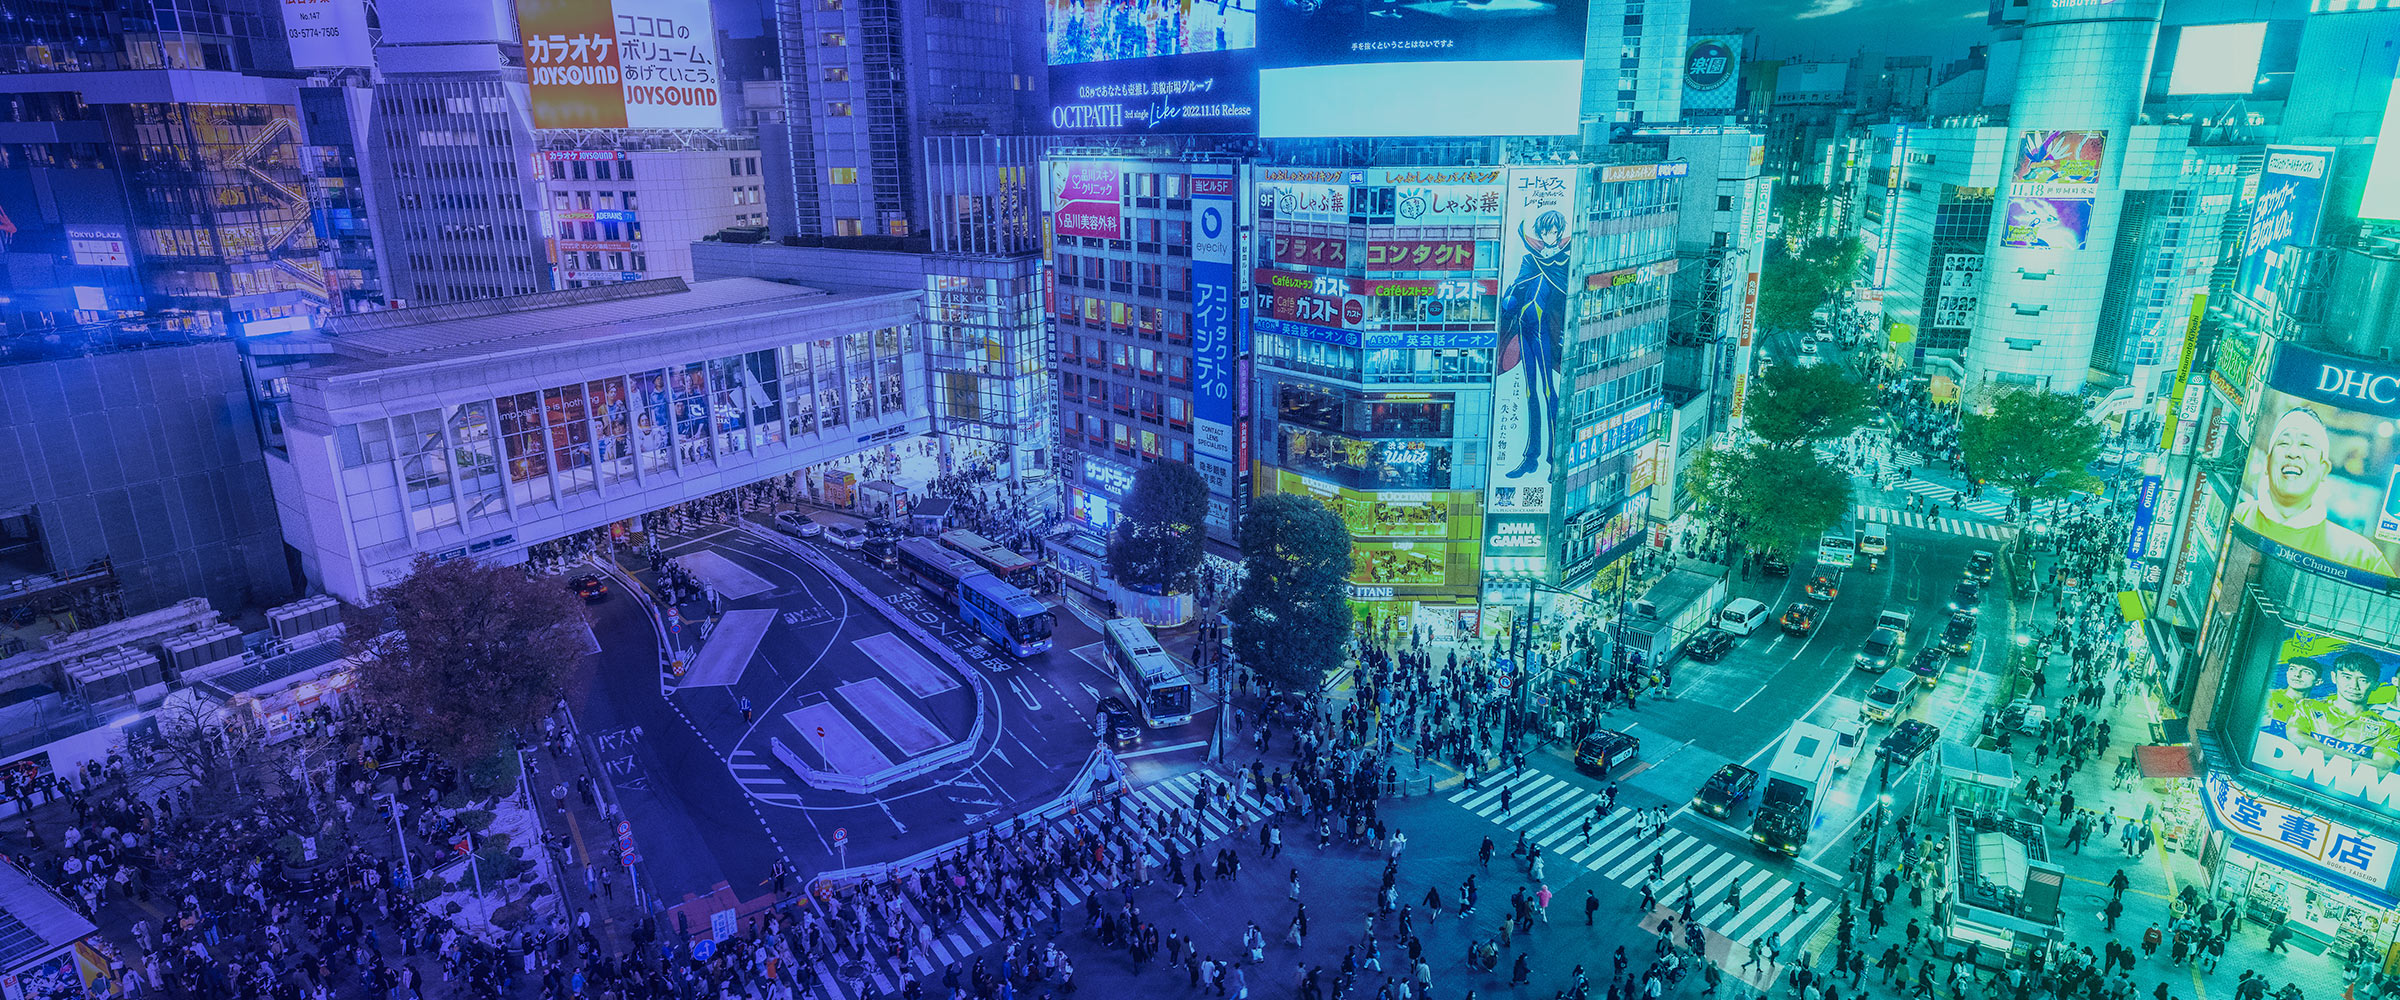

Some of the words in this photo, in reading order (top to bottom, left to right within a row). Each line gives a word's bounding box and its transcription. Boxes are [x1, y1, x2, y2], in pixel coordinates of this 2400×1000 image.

[300, 12, 320, 20] No.147
[618, 14, 690, 39] ココロの
[528, 33, 613, 64] カラオケ
[622, 39, 712, 65] ボリューム、
[1352, 40, 1454, 51] 手を抜くということはないですよ
[533, 65, 619, 85] JOYSOUND
[625, 64, 716, 84] あげていこう。
[1690, 57, 1727, 75] 楽園
[627, 85, 717, 106] JOYSOUND
[1053, 104, 1123, 128] OCTPATH
[1124, 110, 1134, 119] 3rd
[1148, 94, 1181, 129] Like
[1182, 105, 1220, 117] 2022.11.16
[1222, 104, 1251, 116] Release
[1081, 169, 1116, 182] 品川スキン
[1265, 169, 1342, 183] しゃぶしゃぶバイキング
[1386, 171, 1500, 184] しゃぶしゃぶバイキング
[1518, 175, 1566, 191] コードギアス
[1081, 183, 1113, 196] クリニック
[1195, 180, 1229, 192] 当ビル5F
[1760, 183, 1769, 200] BIC
[2012, 184, 2044, 196] 11.18
[1260, 194, 1273, 207] 9F
[1300, 191, 1344, 213] しゃぶ葉
[1433, 191, 1499, 214] しゃぶ葉
[596, 212, 622, 220] ADERANS
[1063, 214, 1117, 232] 品川美容外科
[1754, 201, 1767, 244] CAMERA
[70, 230, 94, 238] TOKYU
[1196, 241, 1228, 256] eyecity
[1276, 238, 1344, 261] プライス
[1368, 244, 1471, 264] コンタクト
[1314, 277, 1350, 297] ガスト
[1438, 281, 1487, 300] ガスト
[1259, 294, 1273, 308] 7F
[1277, 296, 1295, 308] Café
[1296, 297, 1339, 322] ガスト
[1347, 310, 1361, 318] ガスト
[1197, 283, 1213, 397] アイシティ
[1282, 323, 1343, 339] 英会話イーオン
[1215, 285, 1228, 400] コンタクトの
[1370, 335, 1398, 344] AEON
[1406, 335, 1495, 347] 英会話イーオン
[2179, 341, 2194, 383] Matsumoto
[2316, 364, 2400, 404] DHC
[499, 403, 551, 421] impossibe
[551, 402, 560, 411] is
[563, 394, 600, 409] nothng
[1653, 397, 1664, 411] 4F
[1201, 425, 1224, 436] CONTACT
[1206, 433, 1219, 443] LENS
[1198, 438, 1228, 452] SPECIALISTS
[1568, 438, 1597, 465] AGA
[1622, 491, 1649, 513] LUSH
[2144, 481, 2156, 508] MIZUHO
[1498, 522, 1536, 535] DMM
[2383, 522, 2397, 530] DHC
[1490, 535, 1541, 547] GAMES
[2277, 547, 2302, 563] DHC
[2302, 556, 2348, 578] Channel
[2252, 730, 2400, 813] DMM
[2326, 861, 2347, 872] BOOKS
[2349, 868, 2378, 884] TAISEIDO
